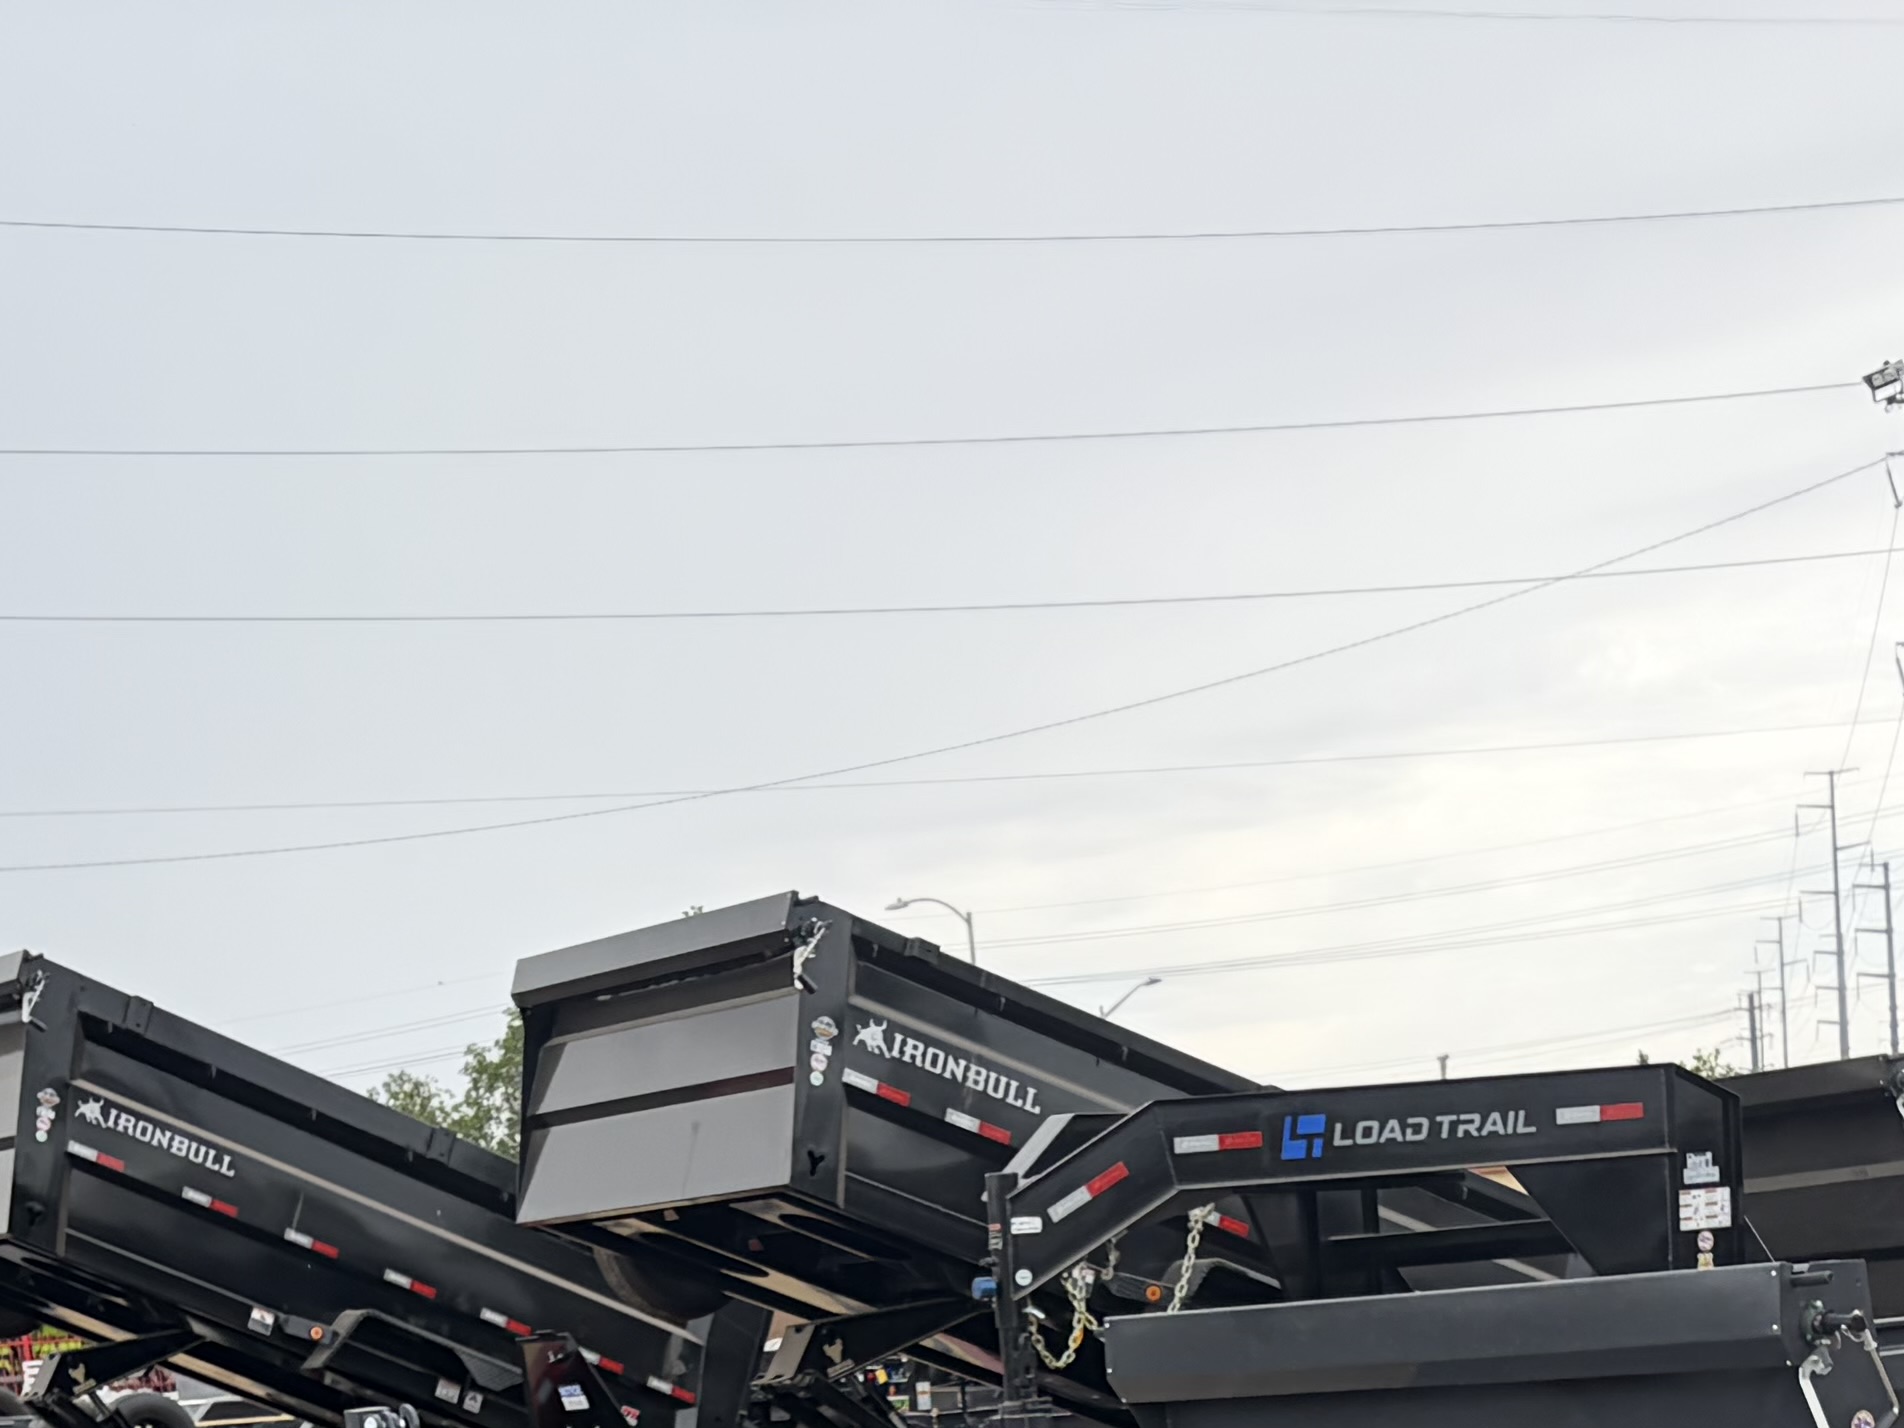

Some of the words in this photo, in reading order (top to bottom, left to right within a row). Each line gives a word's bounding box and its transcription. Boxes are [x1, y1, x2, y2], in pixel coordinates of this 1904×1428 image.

[892, 1032, 1041, 1115] IRONBULL
[107, 1107, 235, 1177] IRONBULL
[1333, 1116, 1430, 1147] LOAD
[1436, 1109, 1537, 1139] TRAIL
